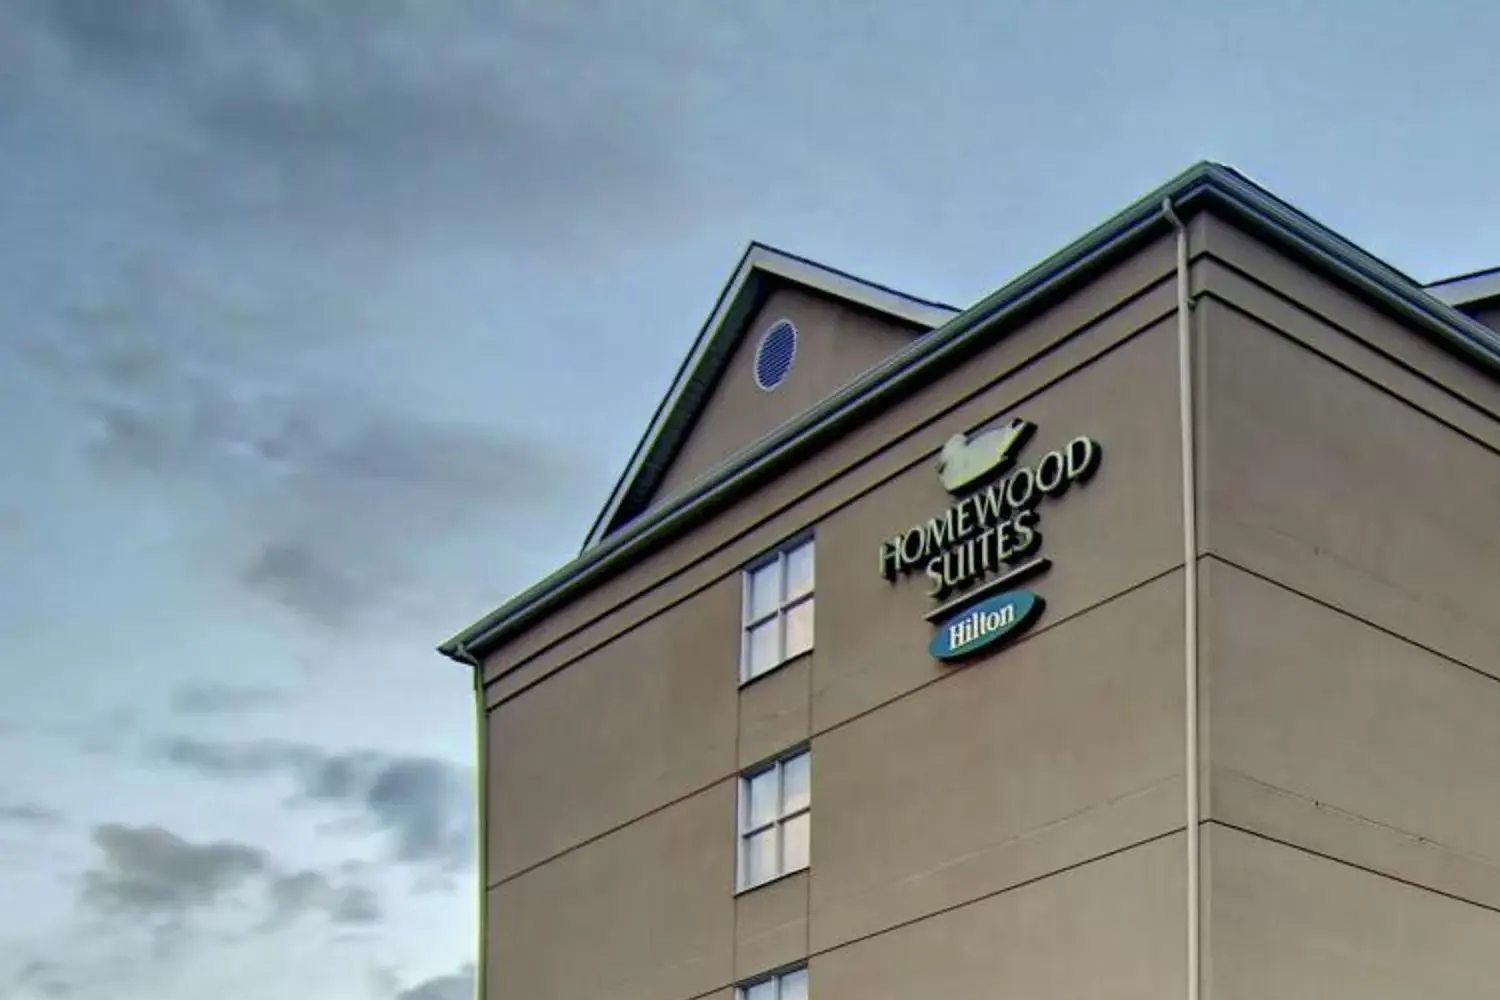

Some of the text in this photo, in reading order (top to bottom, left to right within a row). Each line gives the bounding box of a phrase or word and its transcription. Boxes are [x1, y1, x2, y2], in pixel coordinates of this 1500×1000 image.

[879, 435, 1094, 576] HOMEWOOD
[926, 510, 1033, 596] SUITES
[949, 603, 1015, 651] Hilton
